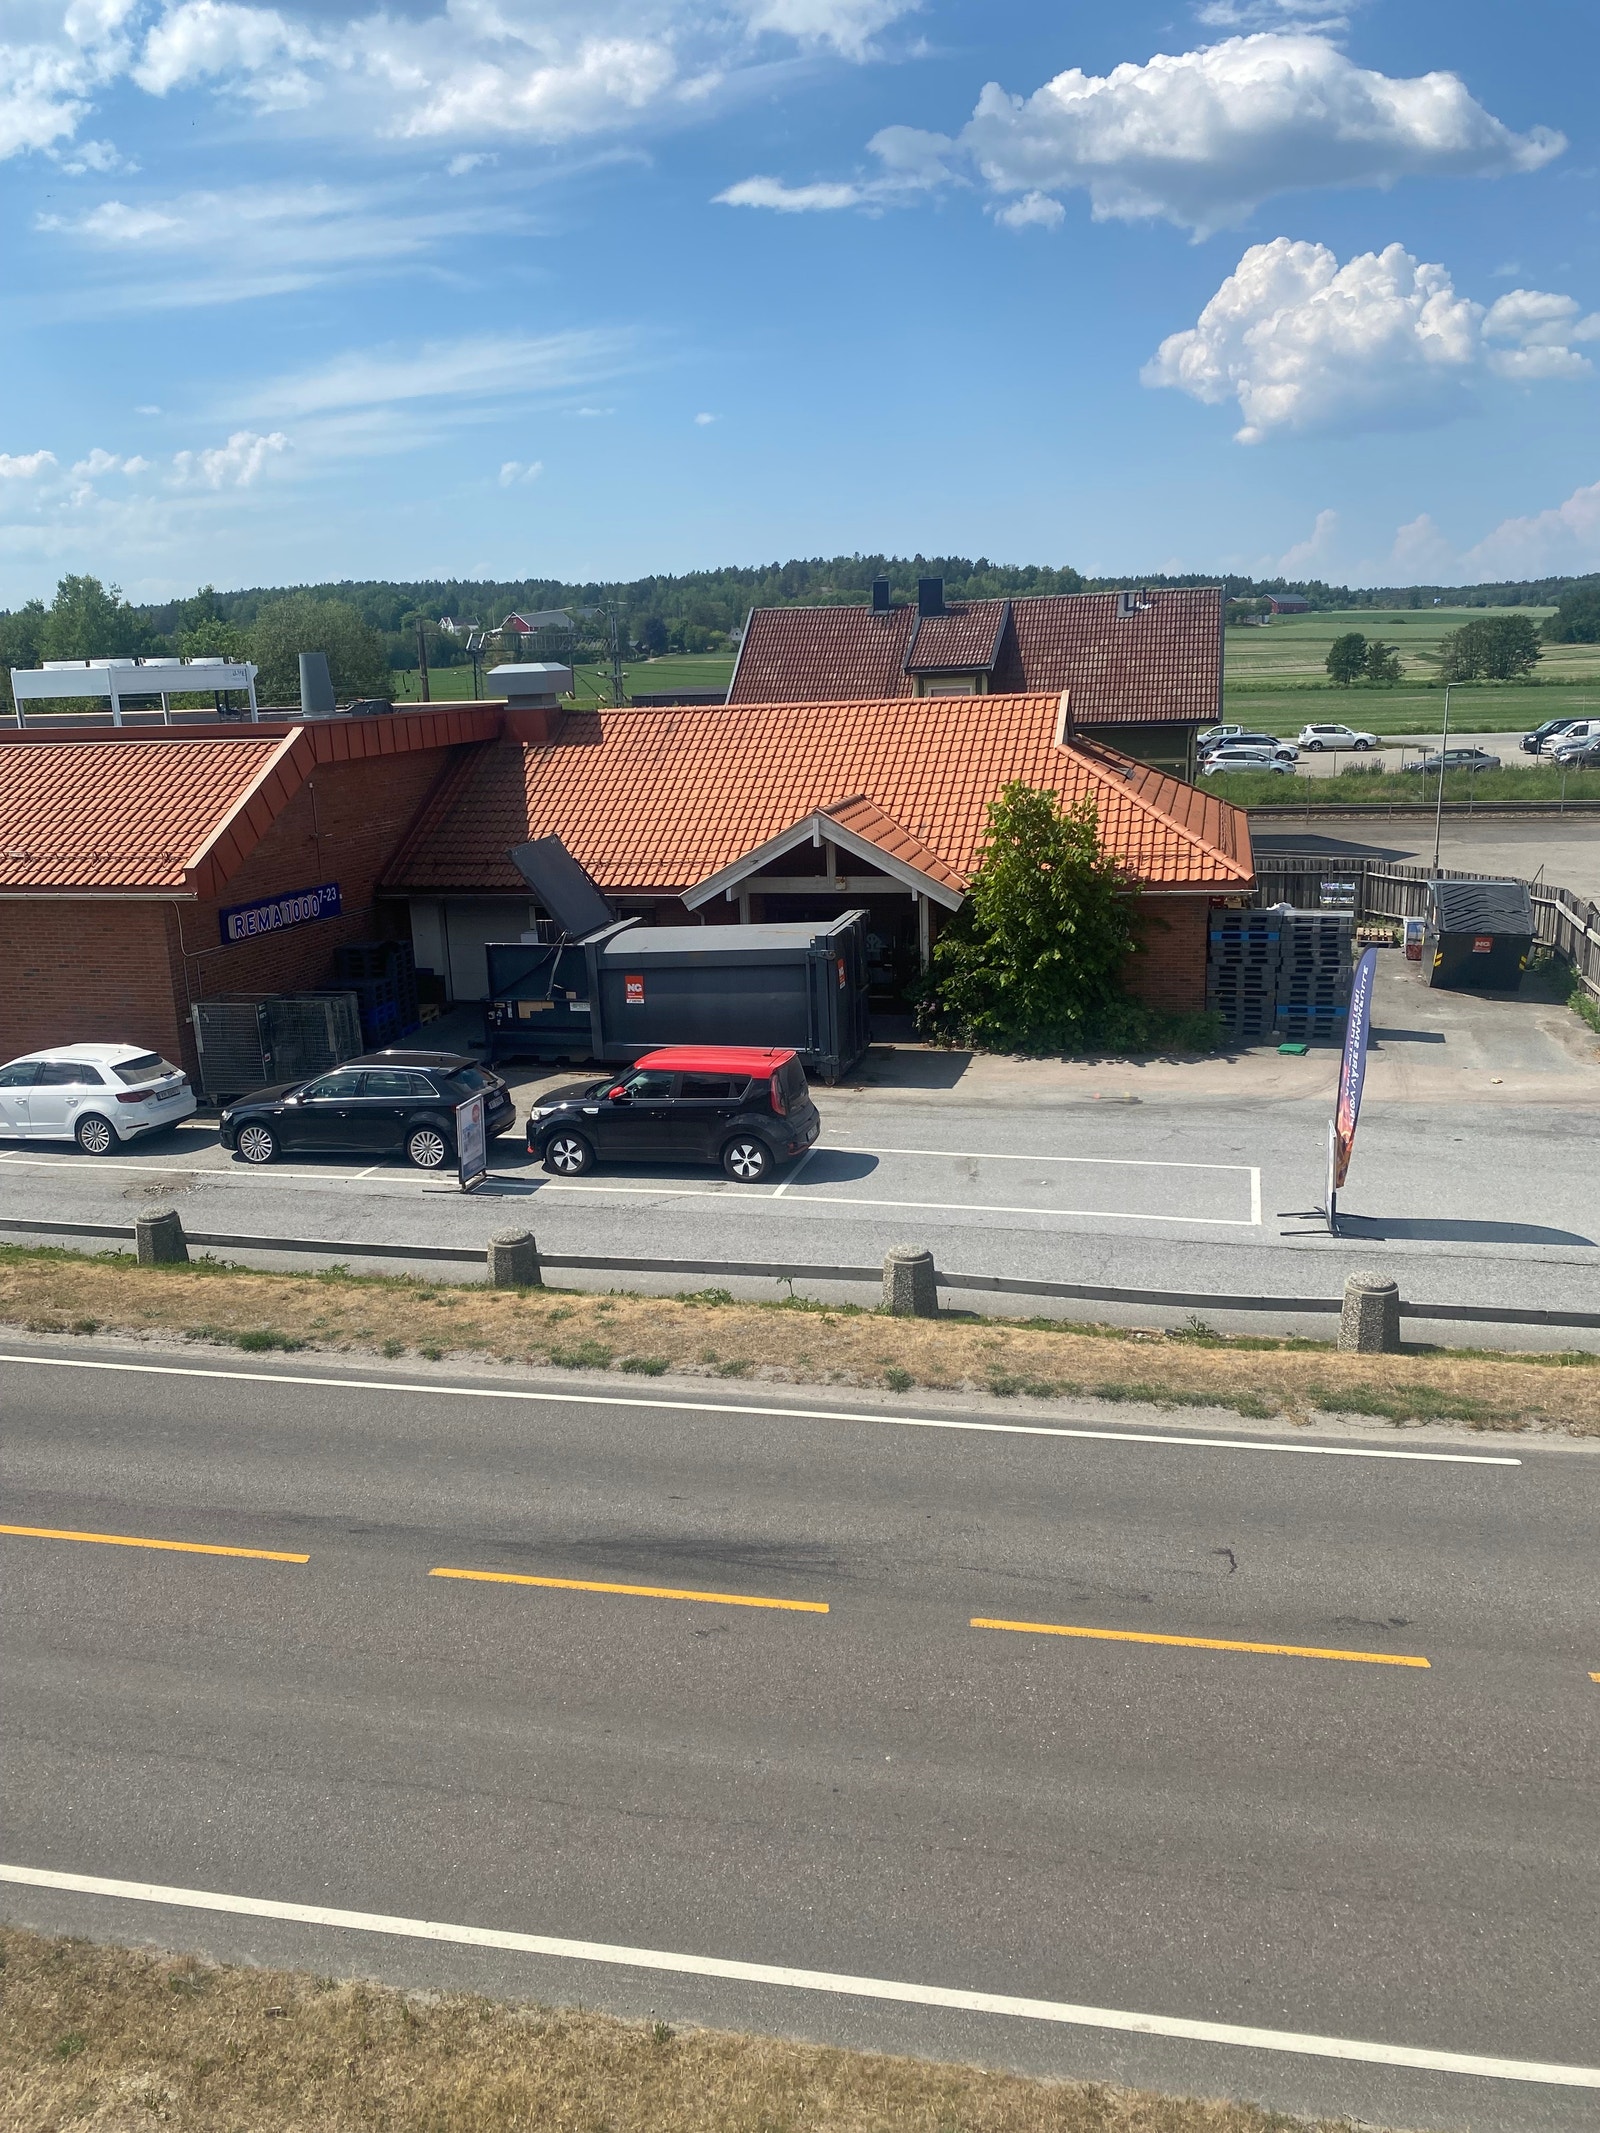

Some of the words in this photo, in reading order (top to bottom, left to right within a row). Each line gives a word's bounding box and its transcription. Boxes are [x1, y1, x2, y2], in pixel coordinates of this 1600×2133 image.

[231, 905, 283, 939] REMA
[284, 895, 320, 924] 1000
[318, 887, 337, 903] 7-23
[627, 983, 643, 992] NG
